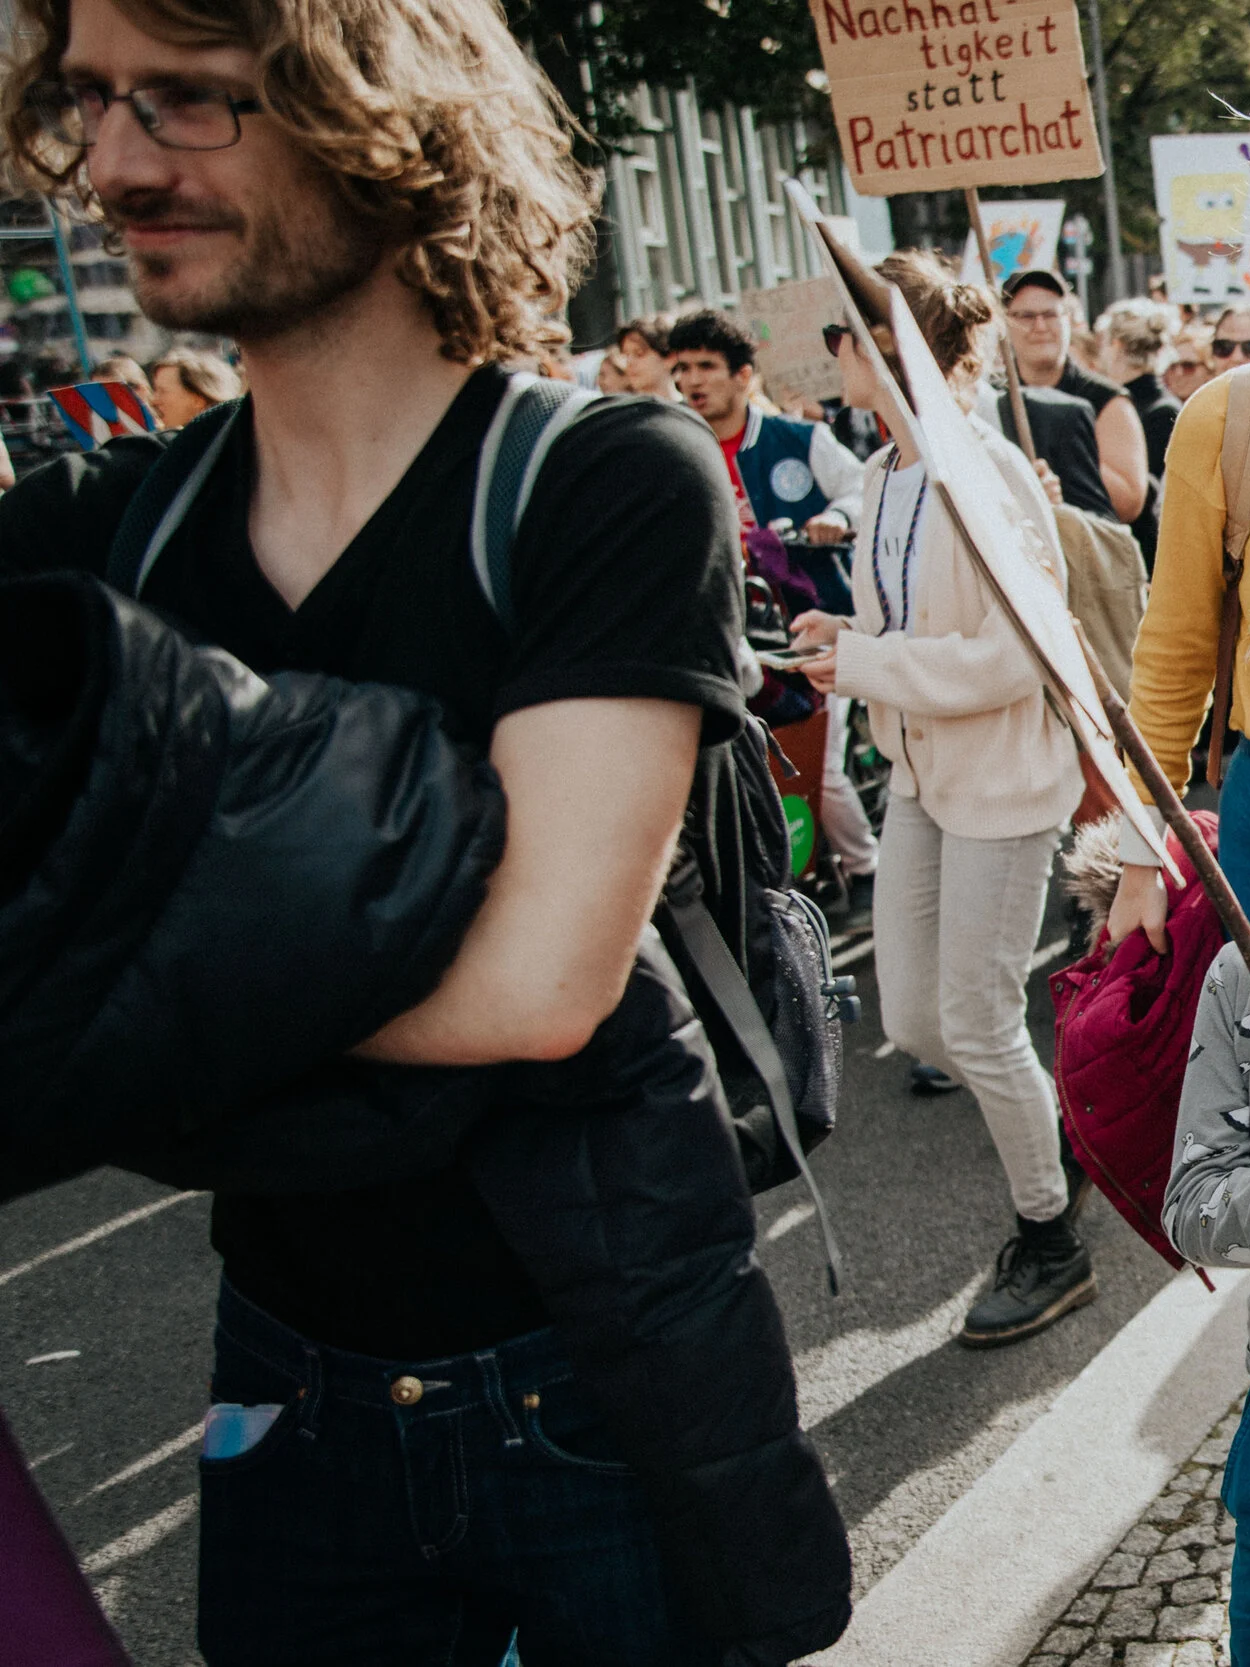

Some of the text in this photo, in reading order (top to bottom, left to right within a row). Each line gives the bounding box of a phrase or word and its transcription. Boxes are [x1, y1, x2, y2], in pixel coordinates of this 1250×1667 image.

[919, 15, 1058, 77] tigkeit
[907, 69, 1007, 113] statt
[848, 100, 1083, 175] Patriarchat
